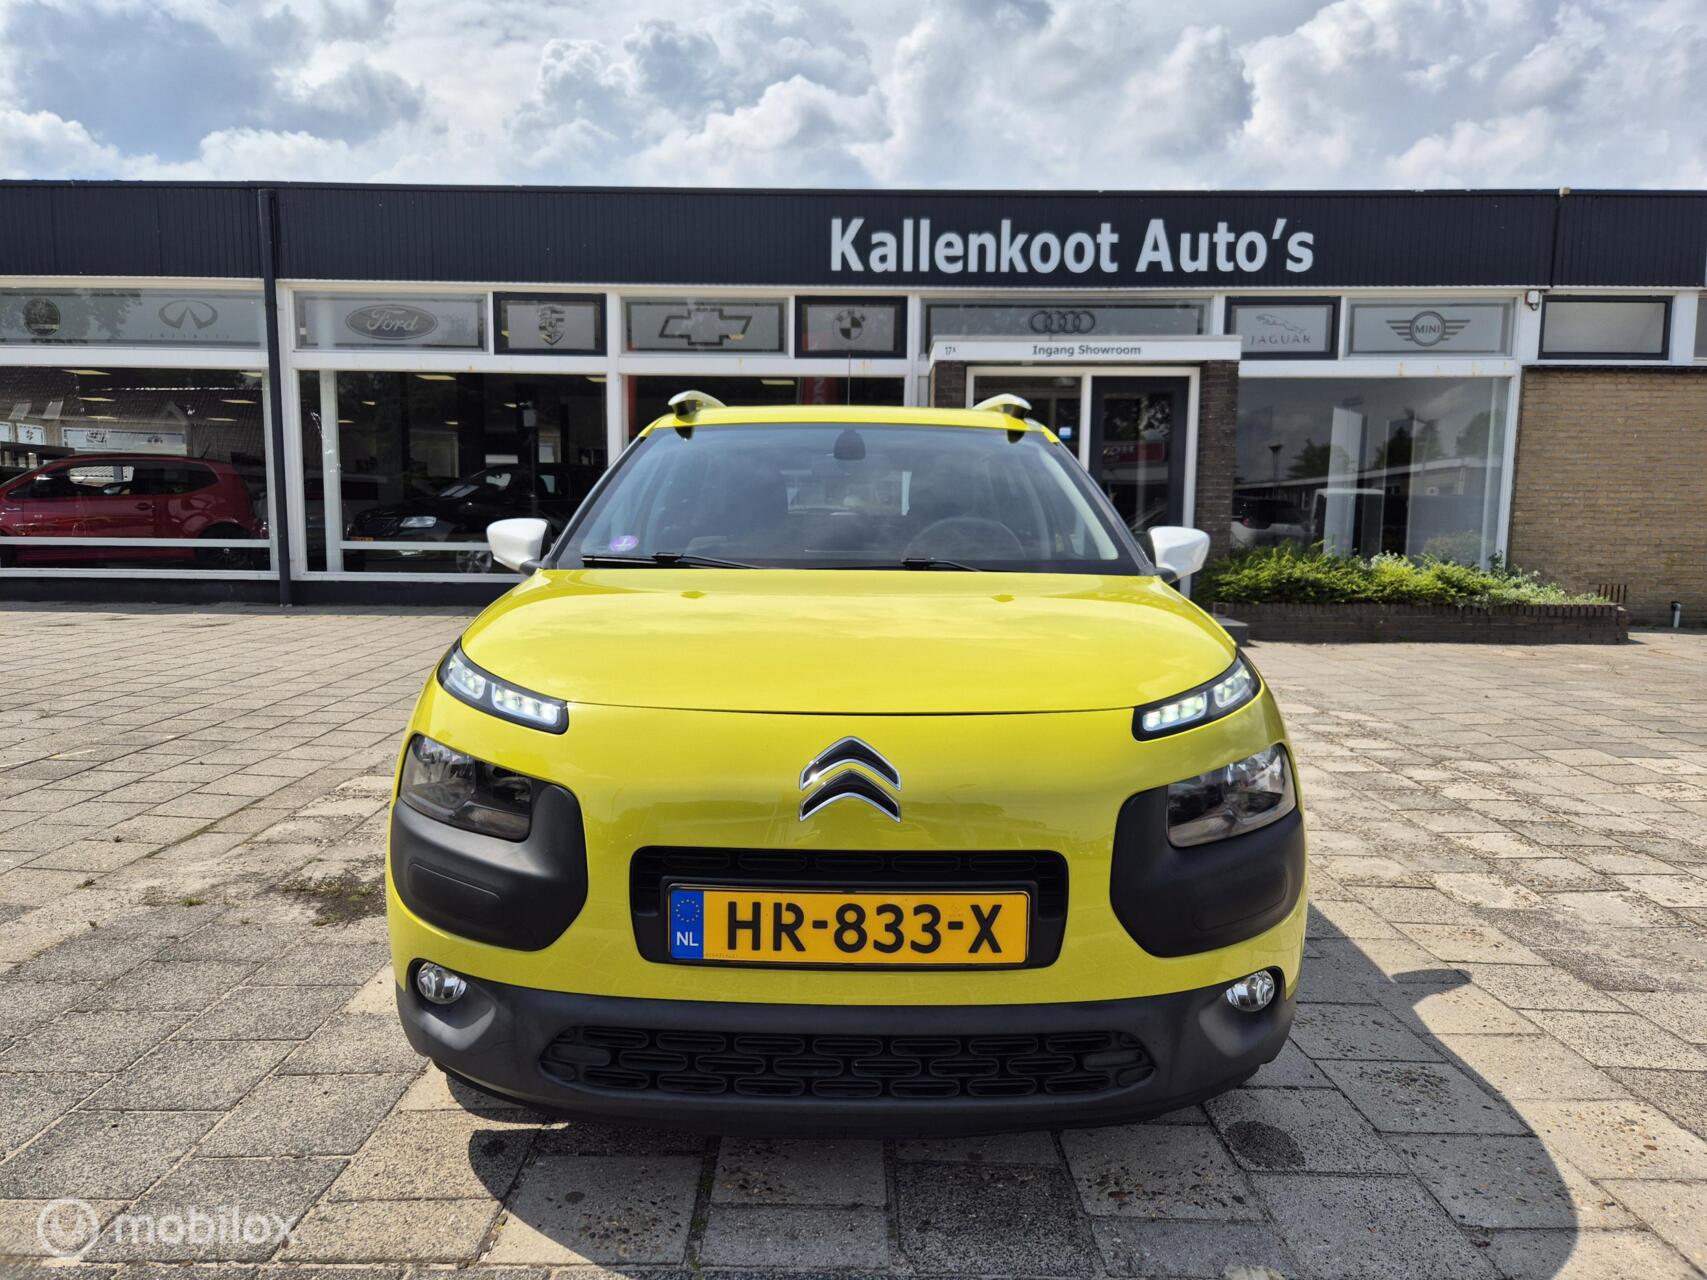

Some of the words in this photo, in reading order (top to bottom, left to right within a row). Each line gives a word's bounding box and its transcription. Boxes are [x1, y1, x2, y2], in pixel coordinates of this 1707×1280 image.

[830, 218, 1119, 273] Kallenkoot
[1136, 218, 1315, 273] Auto's
[367, 308, 420, 331] Ford
[1414, 324, 1441, 334] MINI
[1250, 334, 1311, 345] JAGUAR
[1032, 345, 1075, 357] Ingang
[1078, 345, 1141, 355] Showroom
[727, 901, 1002, 954] HR-833-X
[675, 932, 699, 947] NL
